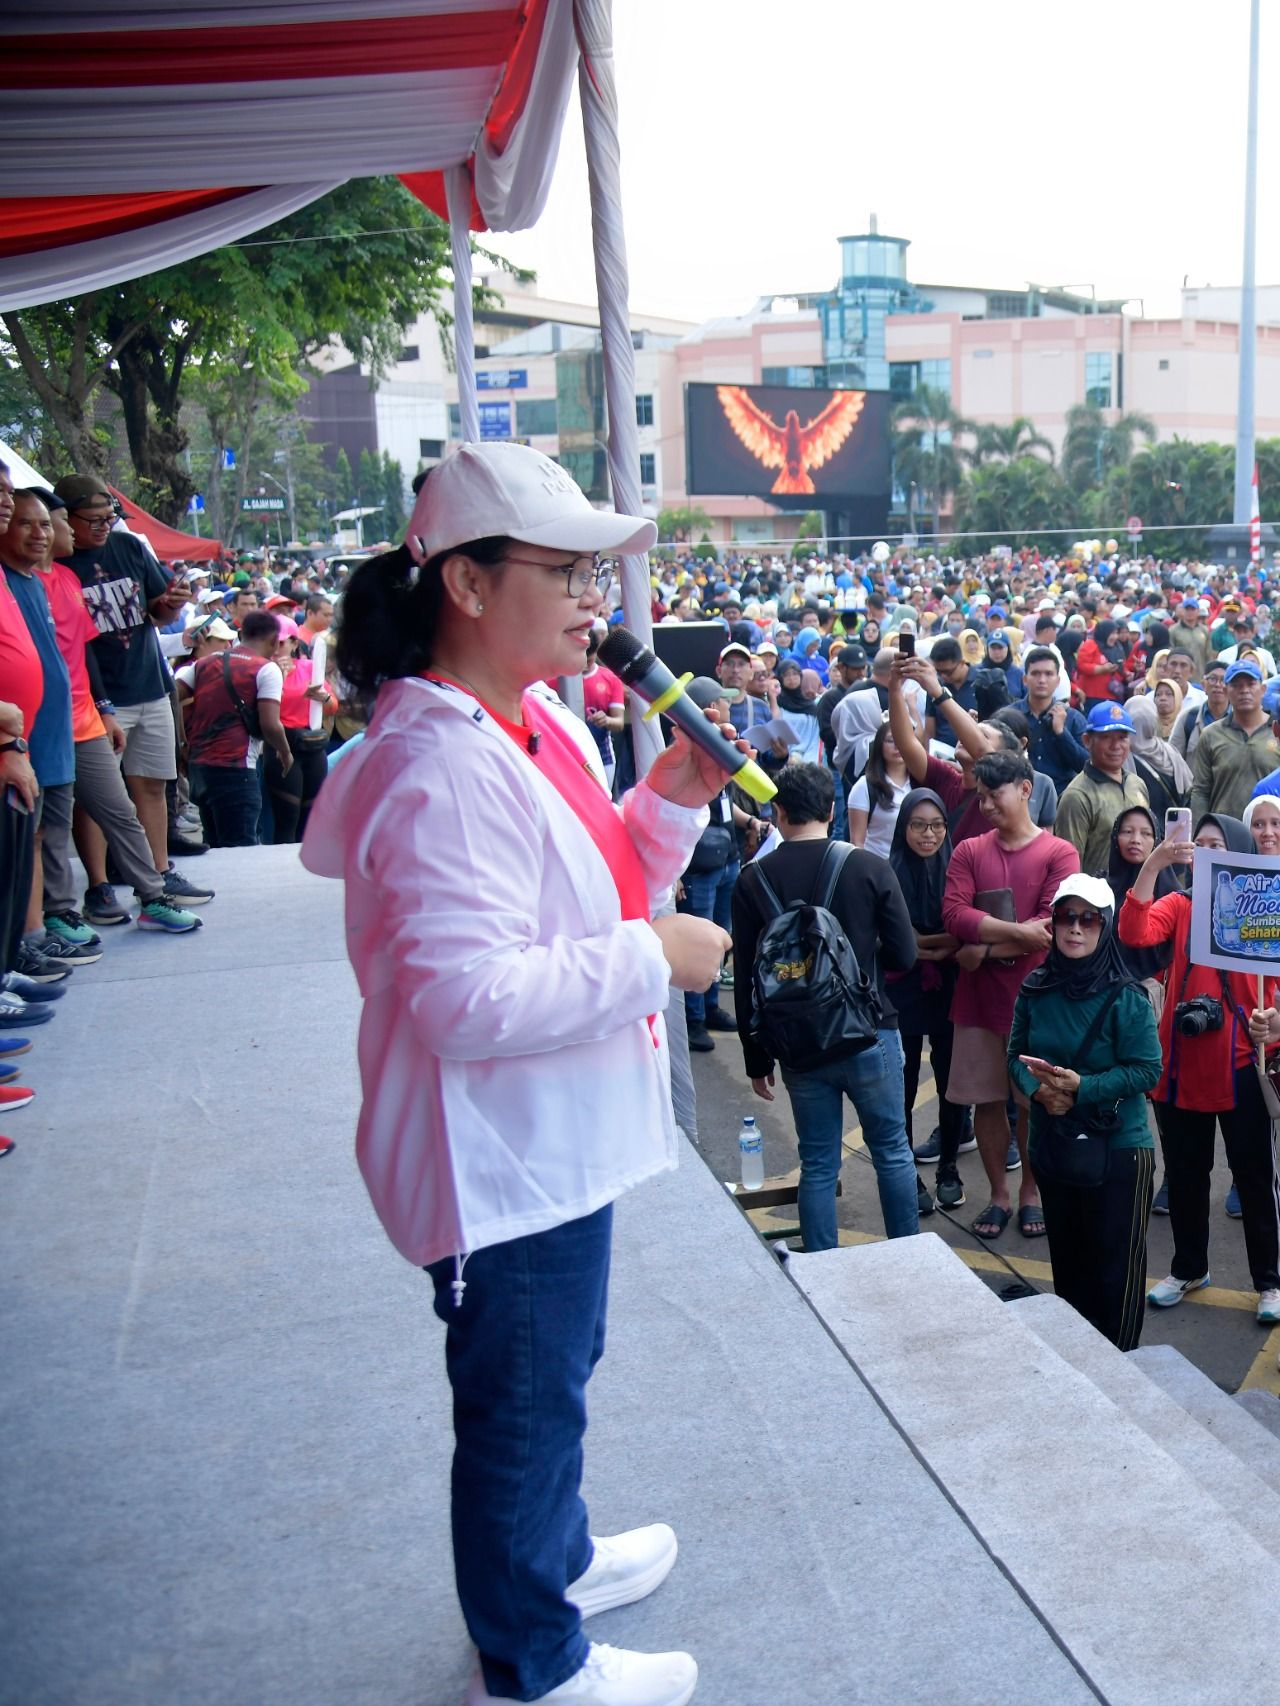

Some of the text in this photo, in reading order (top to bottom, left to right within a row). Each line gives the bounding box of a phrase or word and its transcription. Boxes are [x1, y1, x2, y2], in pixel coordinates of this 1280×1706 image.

[251, 499, 269, 509] GAJAH
[269, 499, 284, 509] MADA
[1242, 874, 1271, 894] Air
